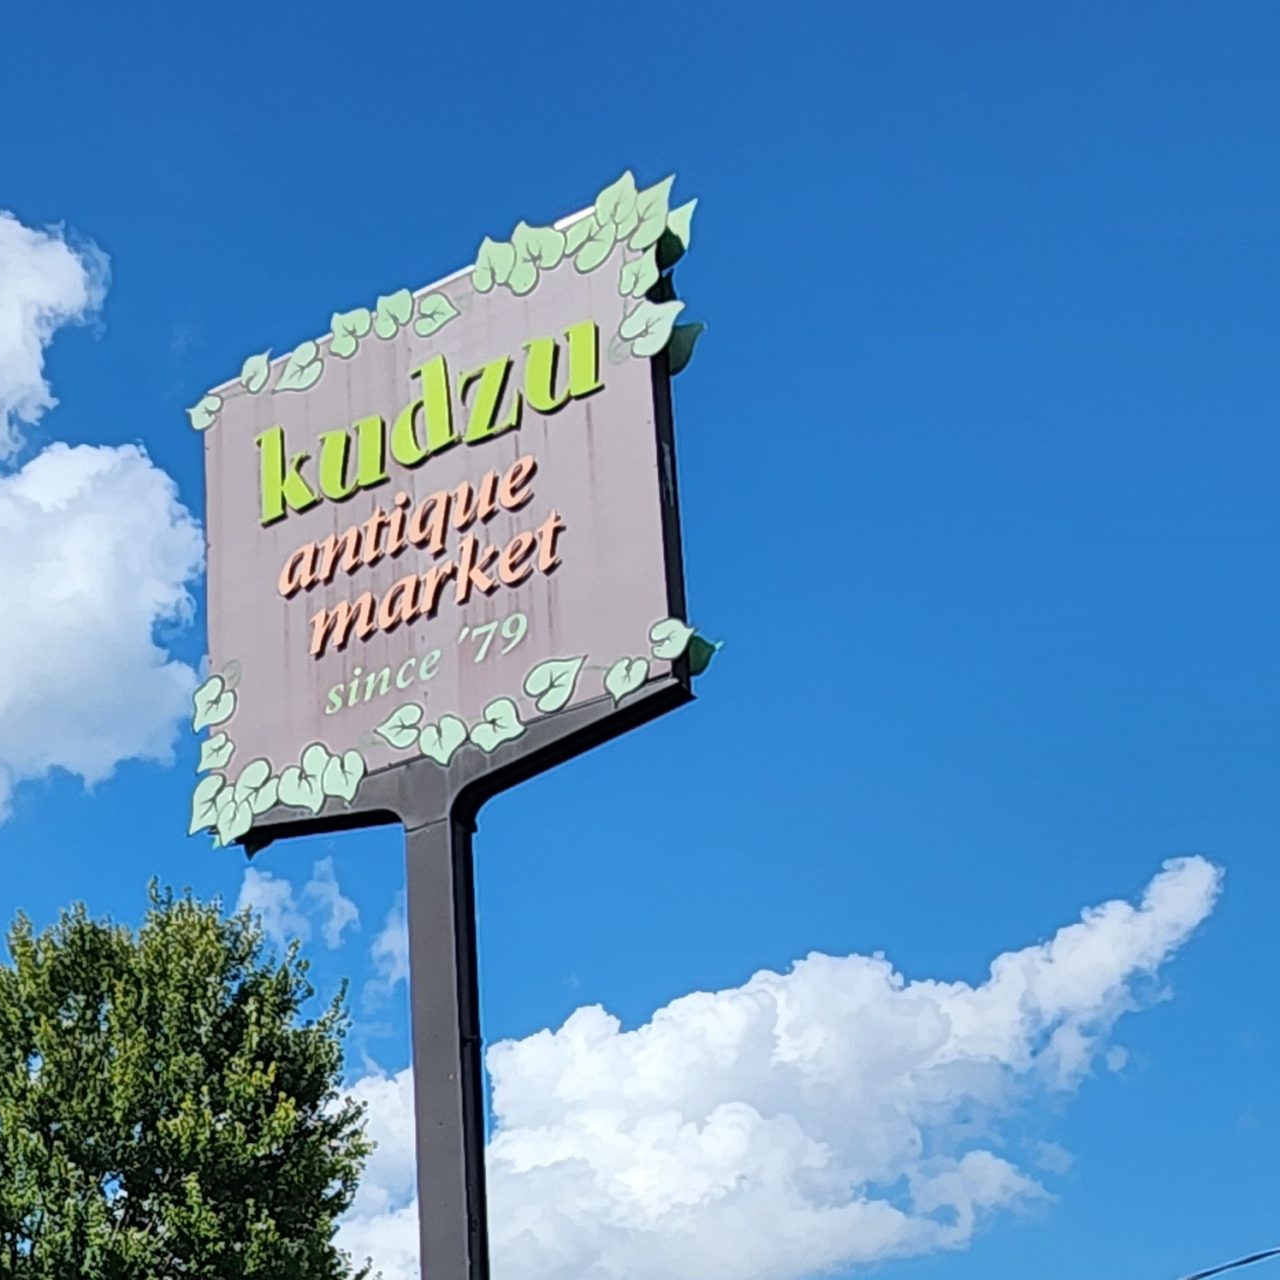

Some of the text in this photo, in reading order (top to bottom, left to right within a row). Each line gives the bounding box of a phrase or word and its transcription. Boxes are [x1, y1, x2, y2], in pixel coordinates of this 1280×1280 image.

[254, 319, 604, 528] kudzu
[277, 454, 538, 600] antique
[308, 509, 566, 661] market
[324, 612, 529, 716] since '79
